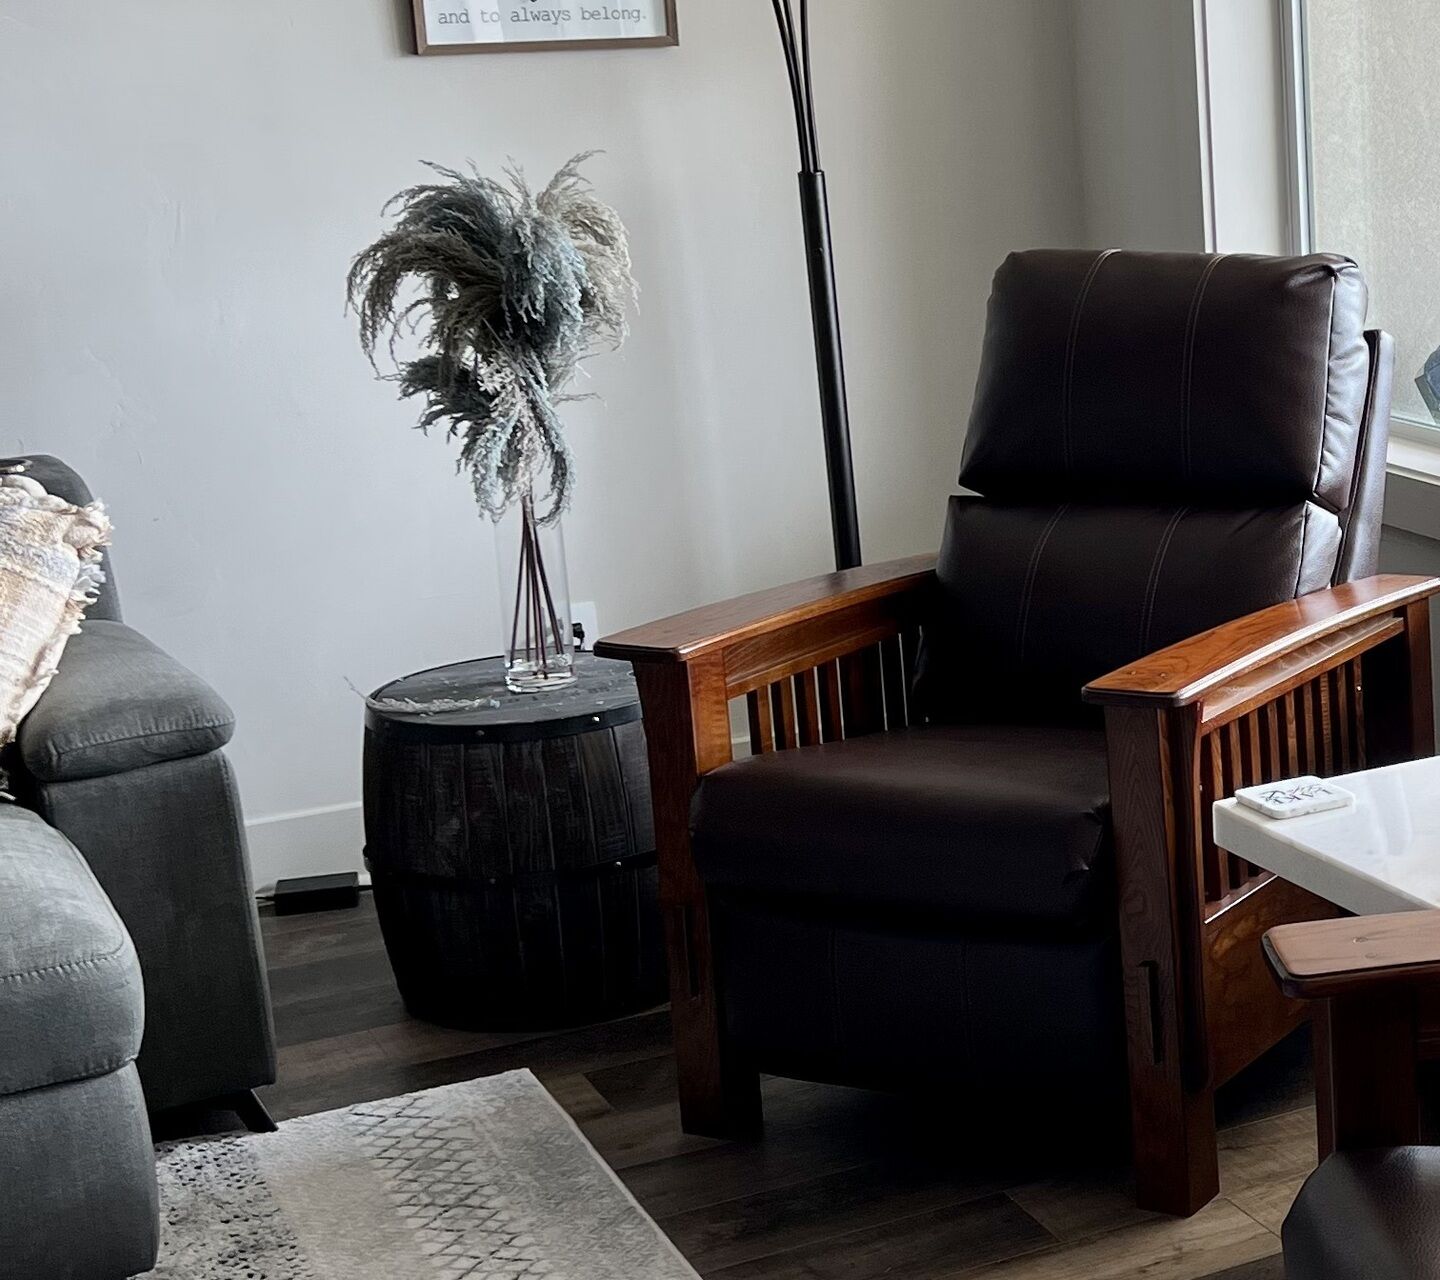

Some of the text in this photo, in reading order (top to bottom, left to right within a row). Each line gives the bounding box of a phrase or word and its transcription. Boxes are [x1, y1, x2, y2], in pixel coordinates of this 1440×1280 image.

[438, 6, 648, 25] and to always belong.
